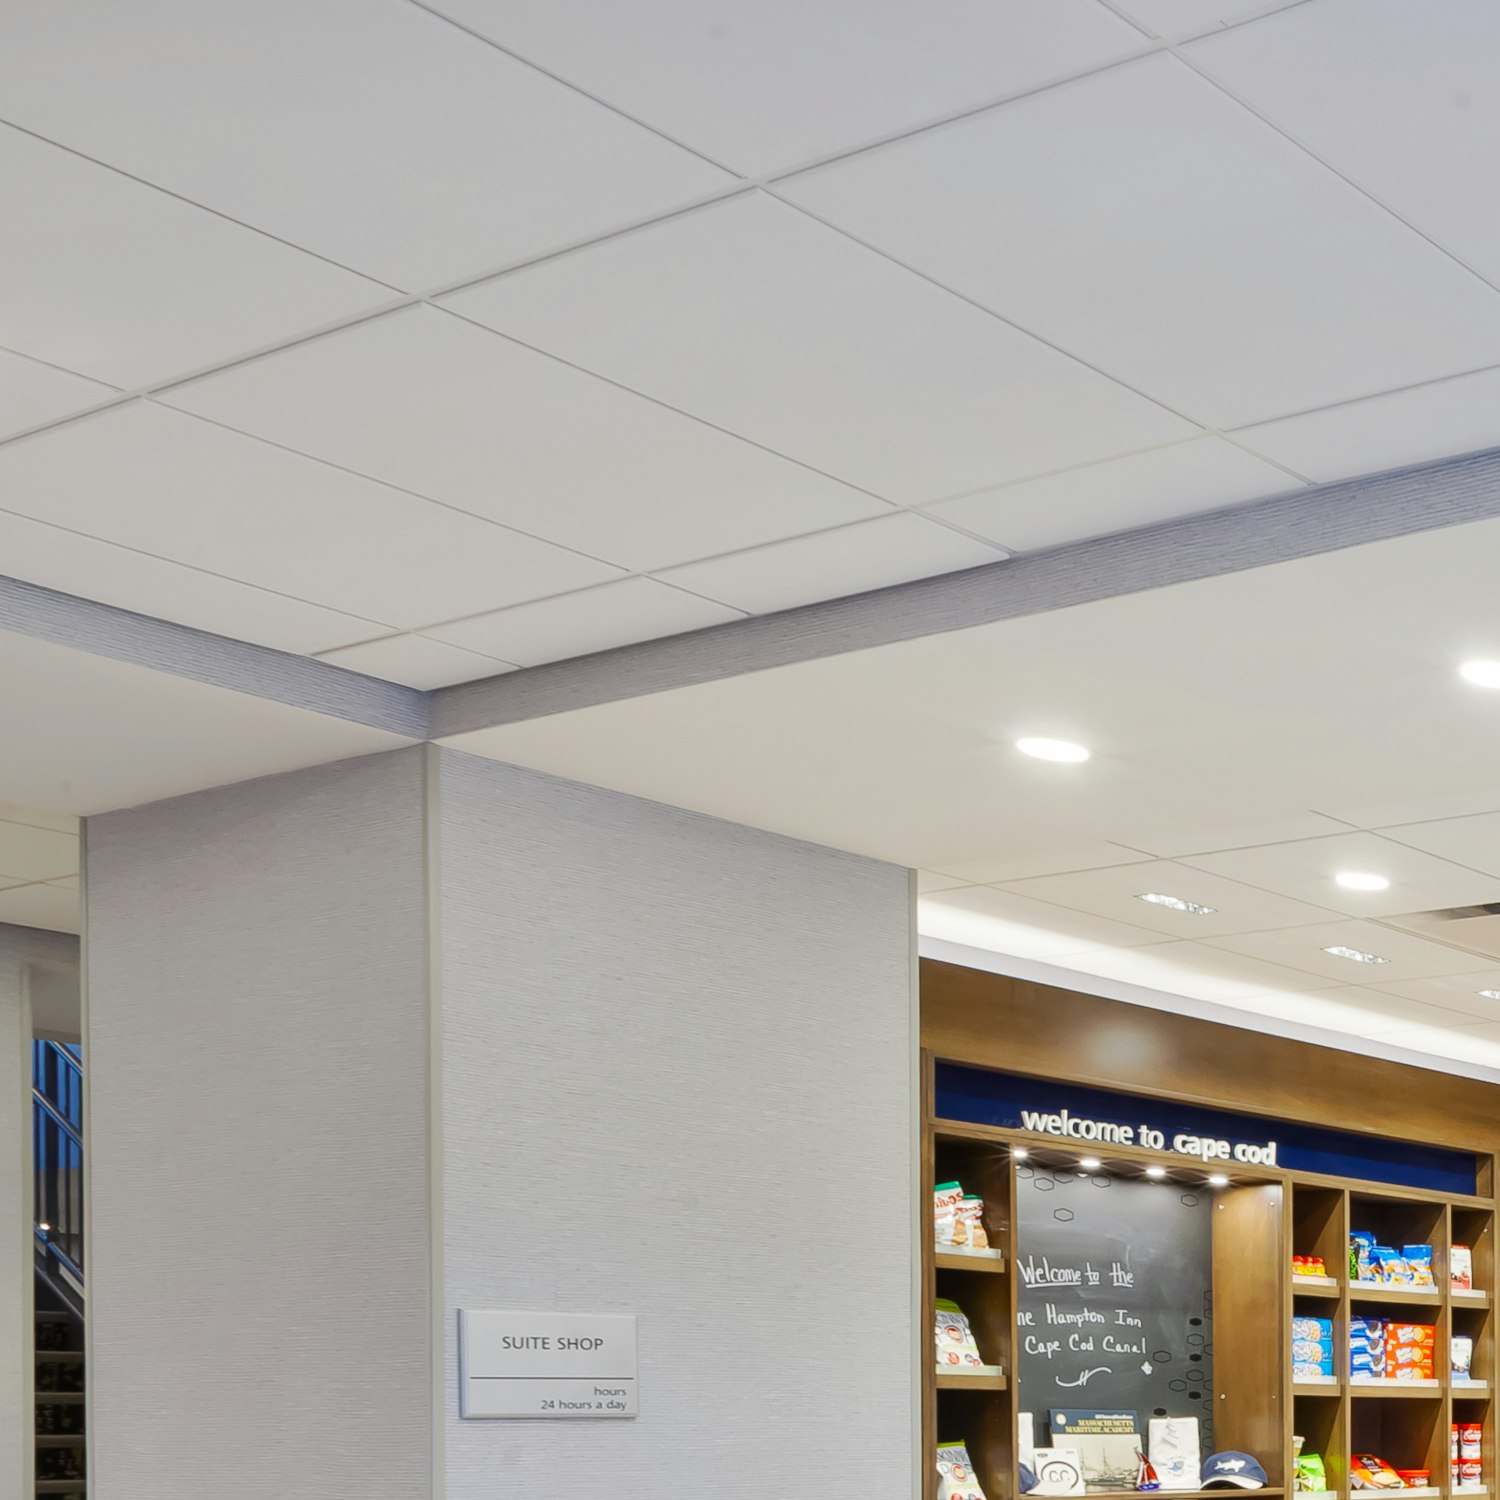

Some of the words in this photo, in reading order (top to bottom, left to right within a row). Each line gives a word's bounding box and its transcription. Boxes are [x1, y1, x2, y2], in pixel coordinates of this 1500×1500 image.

[1021, 1109, 1134, 1145] welcome
[1137, 1124, 1165, 1149] to
[1173, 1133, 1231, 1163] cape
[1234, 1142, 1277, 1166] cod
[1017, 1255, 1082, 1285] Welcome
[1084, 1262, 1100, 1284] to
[1109, 1262, 1134, 1285] the
[1045, 1303, 1106, 1328] Hampton
[1114, 1309, 1142, 1328] Inn
[502, 1336, 551, 1350] SUITE
[557, 1337, 604, 1351] SHOP
[1025, 1334, 1062, 1359] Cape
[1069, 1334, 1094, 1351] Cod
[1102, 1335, 1147, 1354] Canal
[593, 1386, 627, 1396] hours
[540, 1400, 555, 1410] 24
[558, 1400, 592, 1410] hours
[595, 1402, 603, 1410] a
[606, 1401, 627, 1412] day
